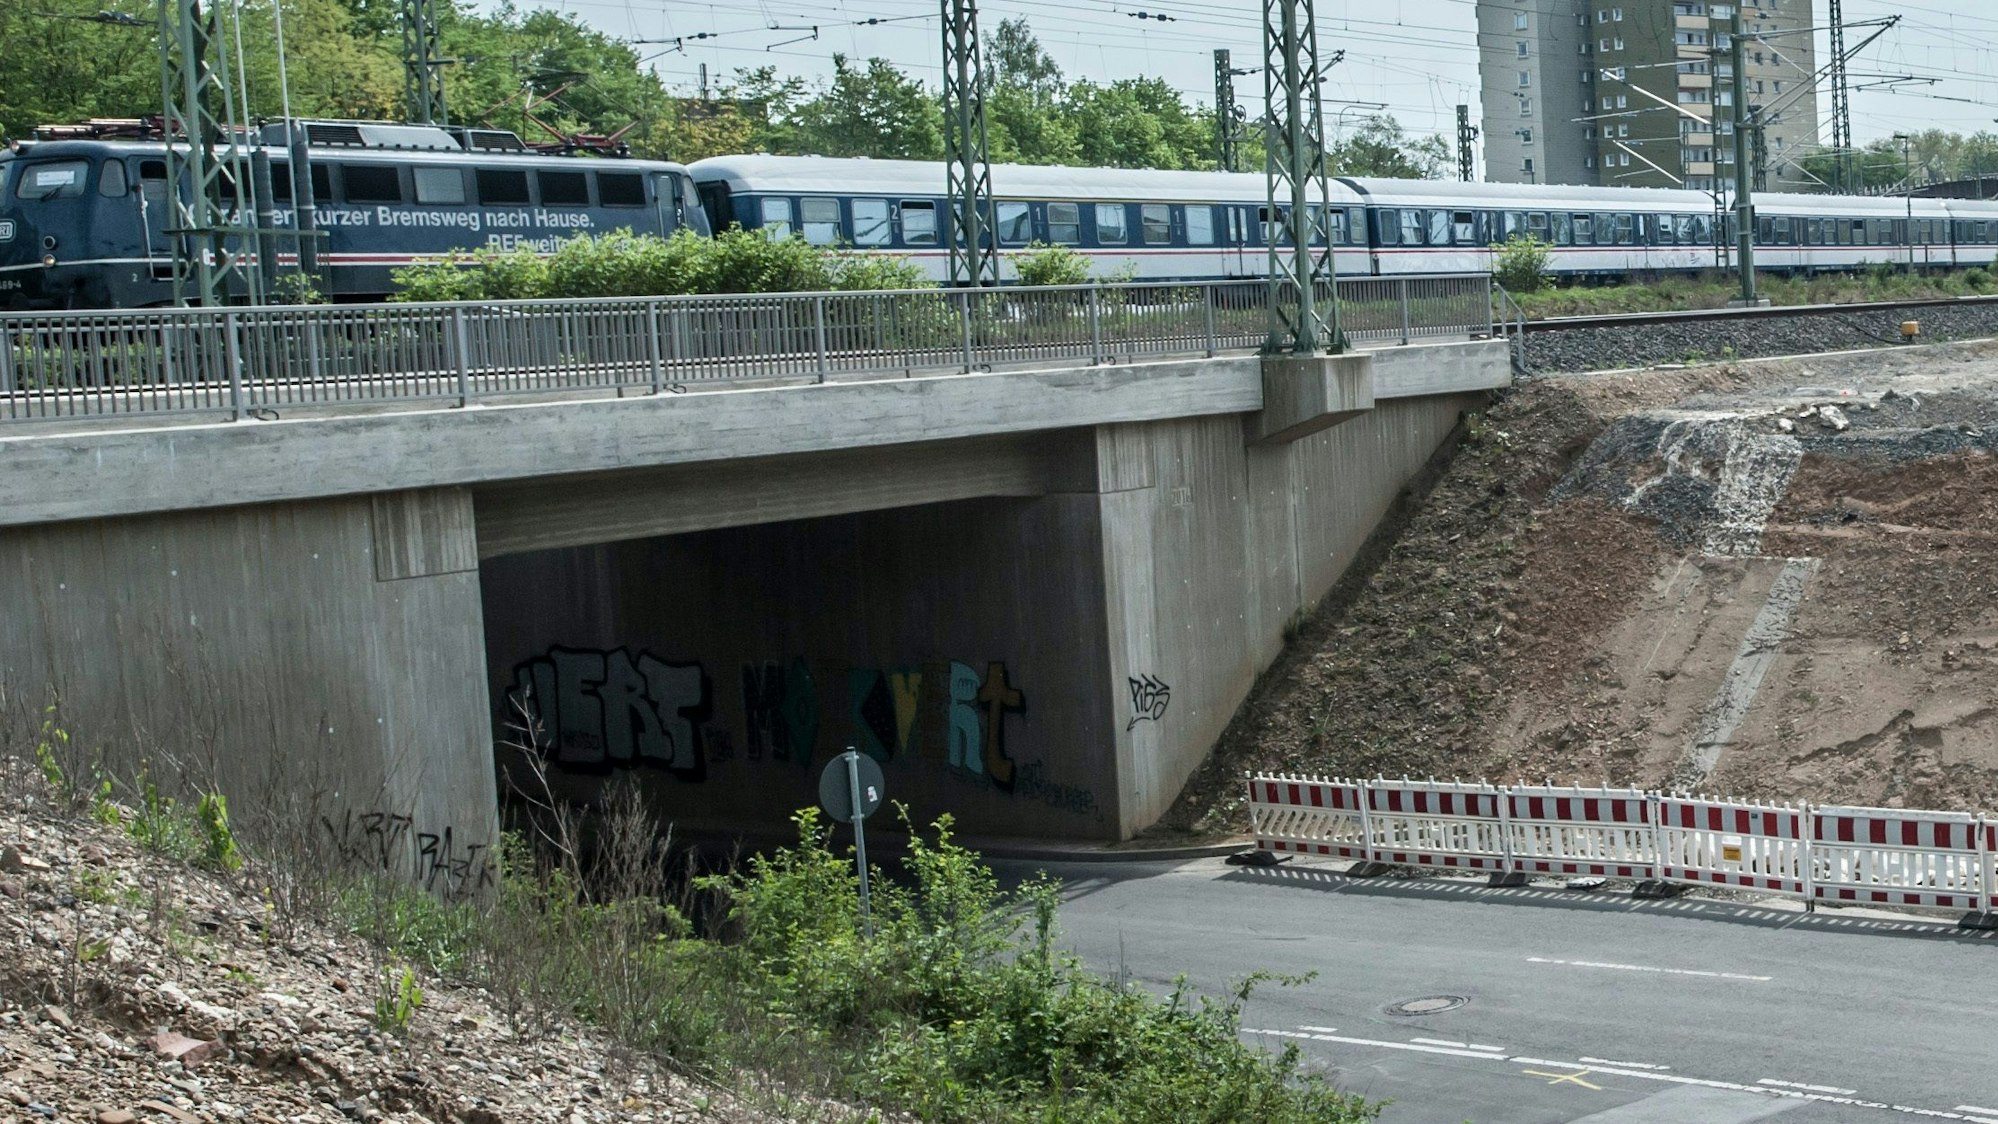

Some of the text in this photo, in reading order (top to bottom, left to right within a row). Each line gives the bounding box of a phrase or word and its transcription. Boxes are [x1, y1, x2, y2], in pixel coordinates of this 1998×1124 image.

[378, 207, 479, 231] Bremsweg
[486, 209, 530, 227] nach
[535, 209, 595, 228] Hause.
